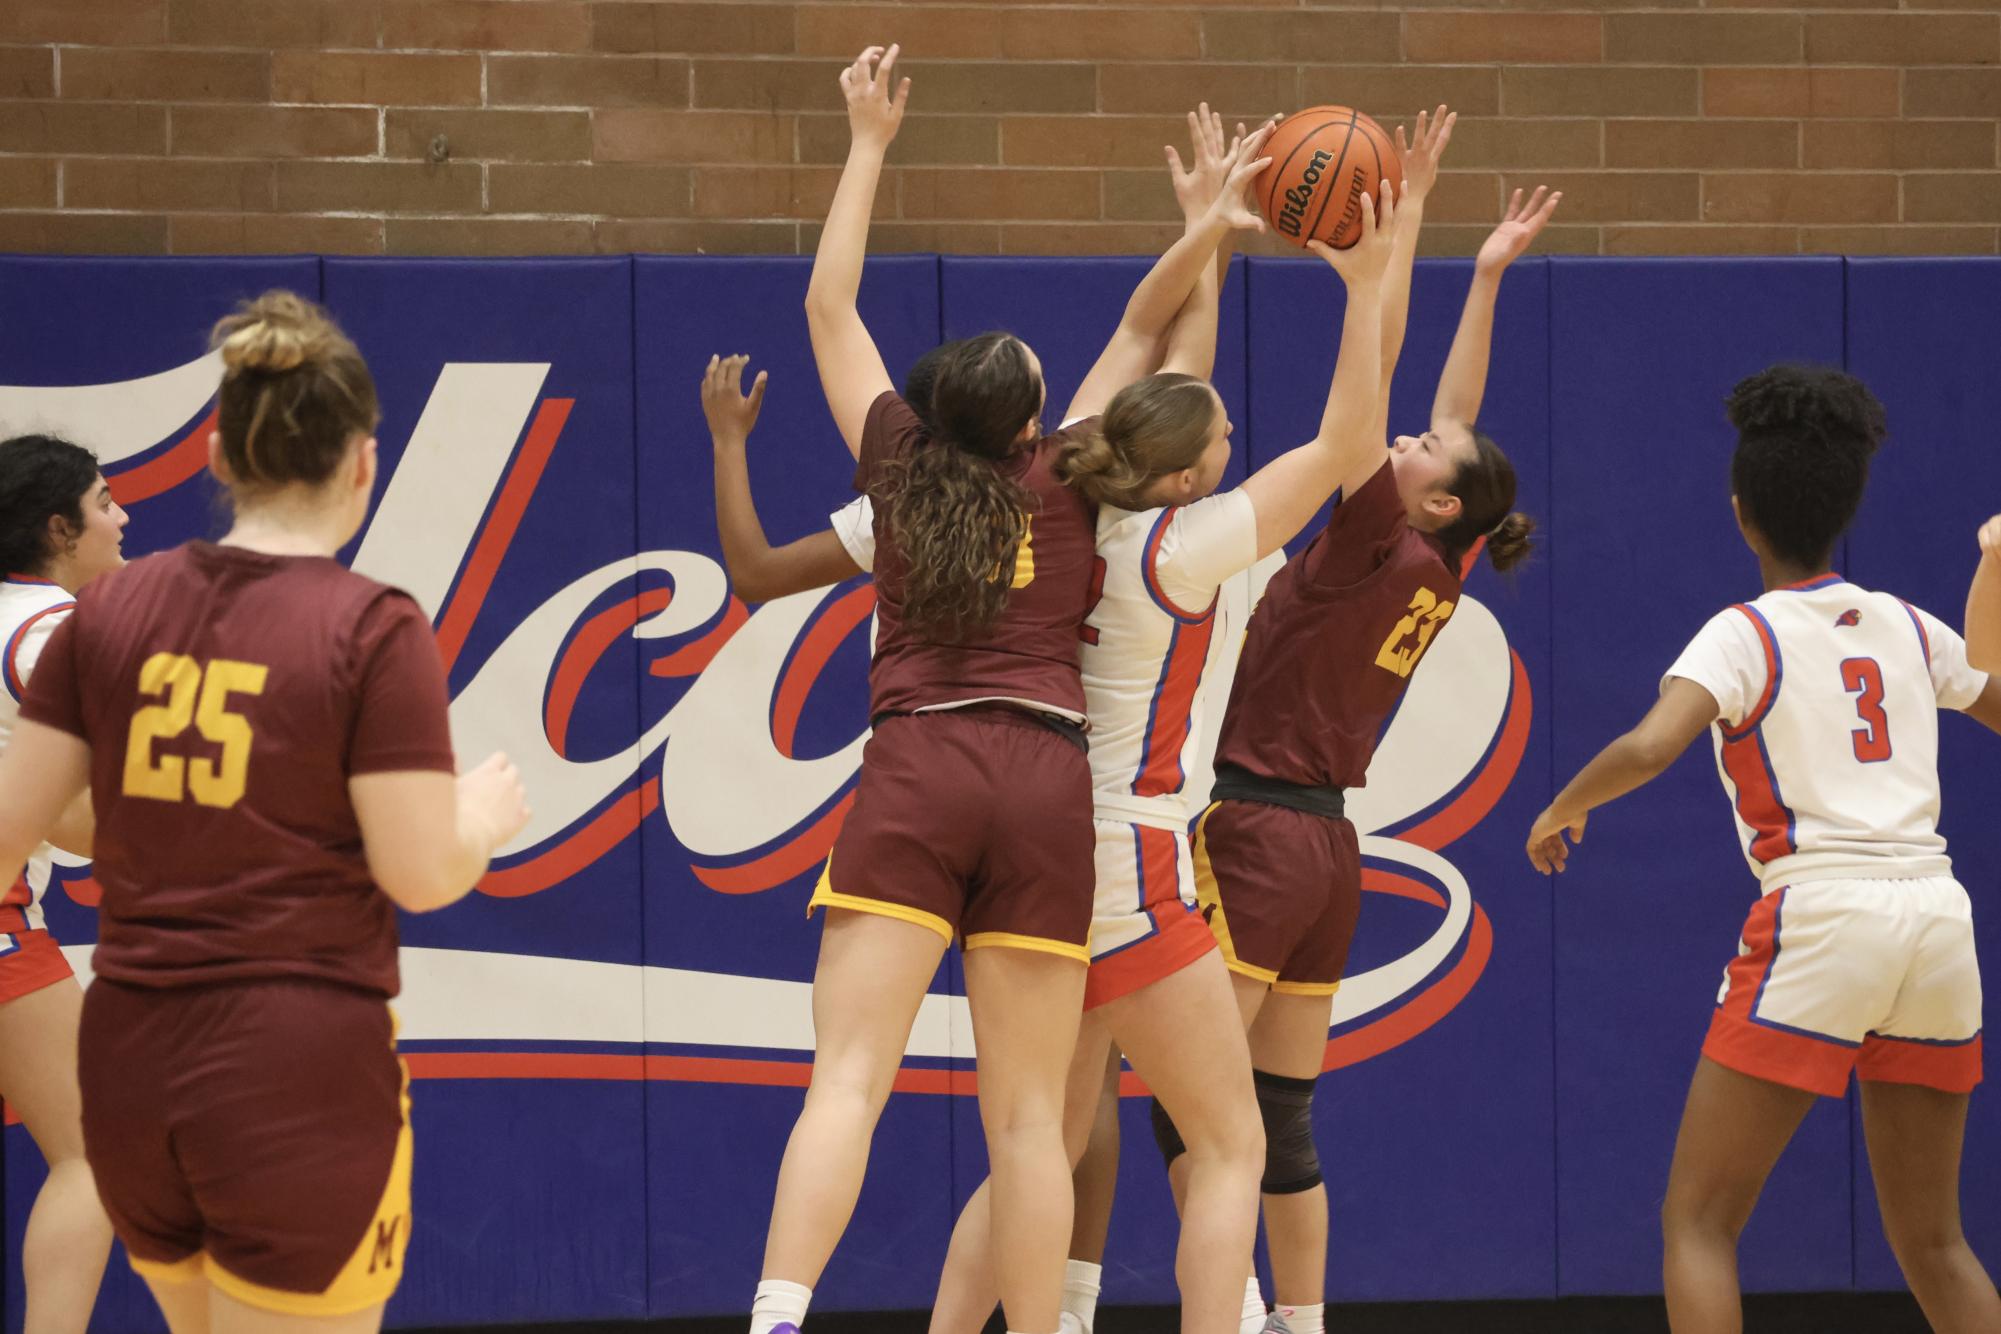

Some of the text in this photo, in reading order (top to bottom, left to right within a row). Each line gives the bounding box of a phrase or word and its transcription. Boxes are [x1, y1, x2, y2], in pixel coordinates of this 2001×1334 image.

[1278, 149, 1333, 237] Wilson
[1375, 586, 1455, 678] 23
[122, 652, 269, 809] 25
[1839, 656, 1893, 763] 3
